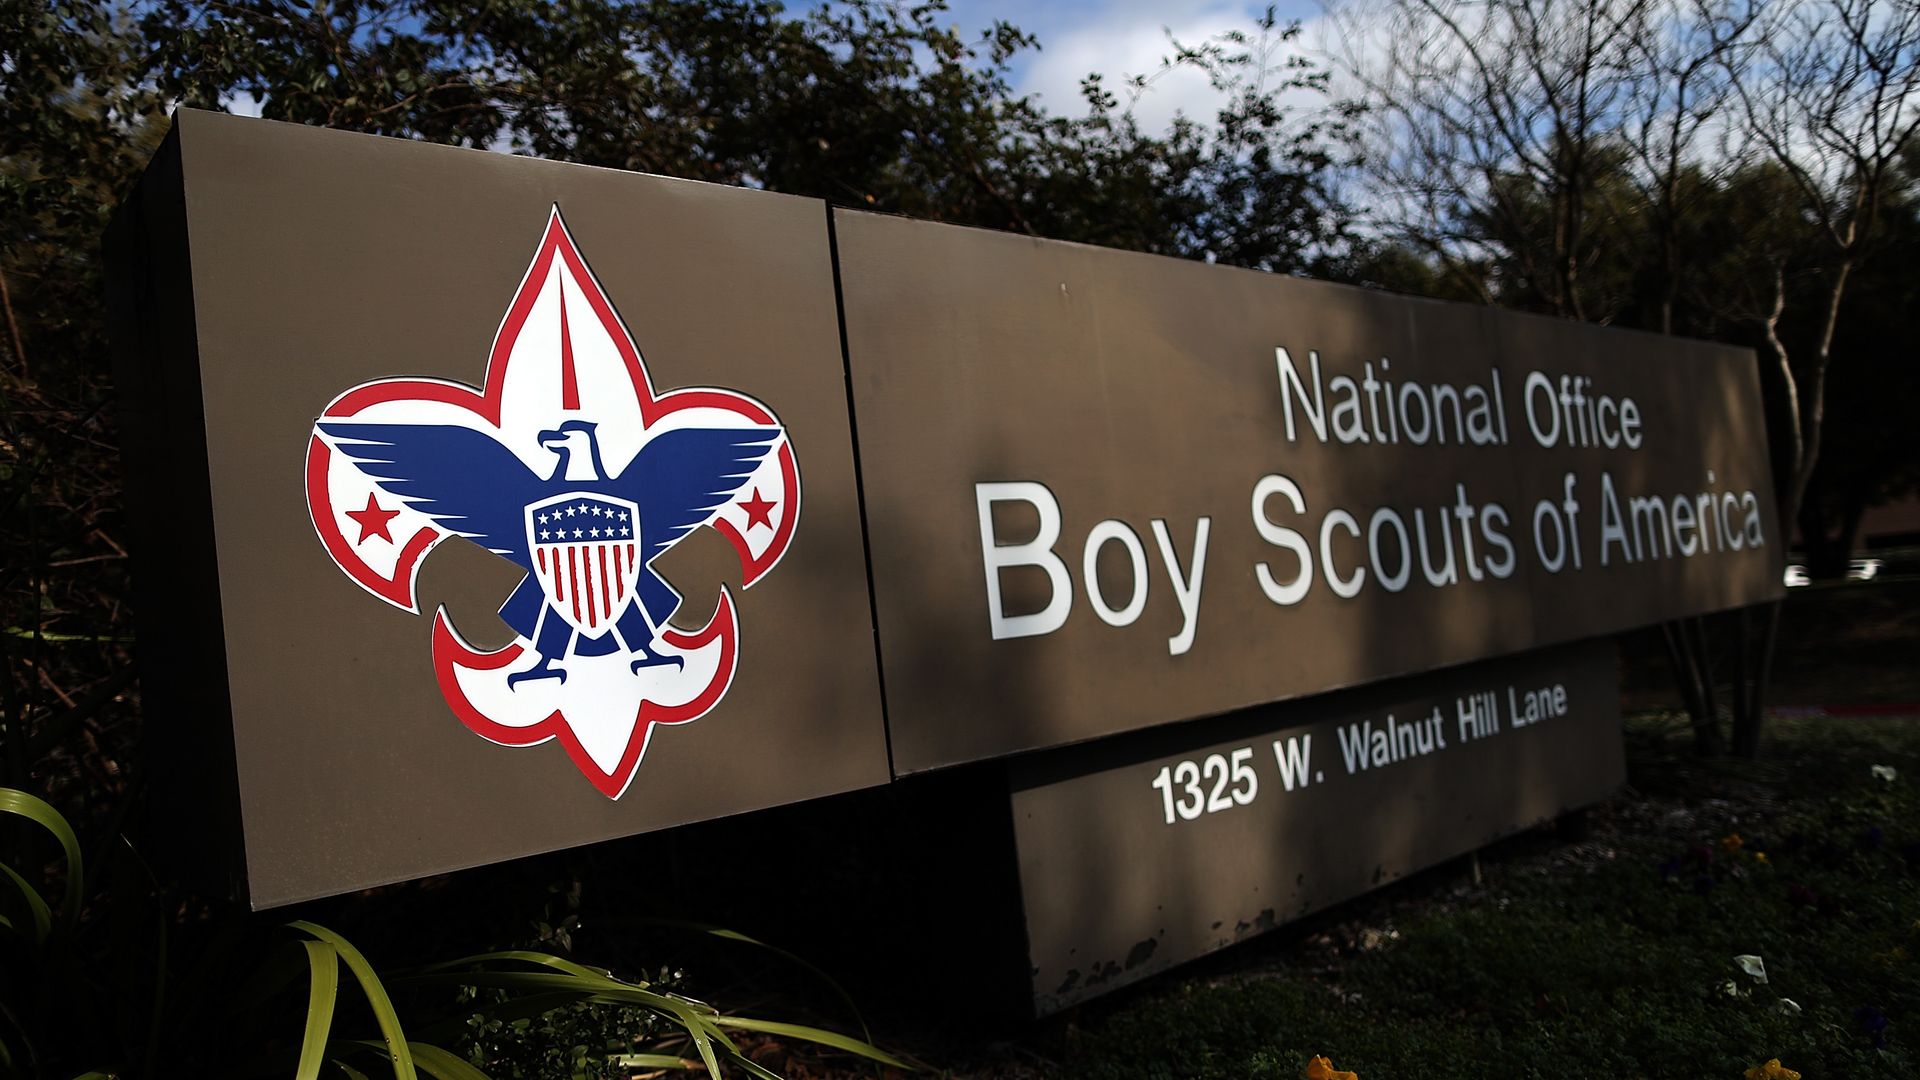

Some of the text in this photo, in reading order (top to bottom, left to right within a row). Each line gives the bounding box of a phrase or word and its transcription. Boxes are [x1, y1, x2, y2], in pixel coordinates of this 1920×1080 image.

[1275, 346, 1643, 449] National Office
[975, 469, 1764, 656] Boy Scouts of America
[1152, 684, 1567, 825] 1325 W. Walnut Hill Lane
